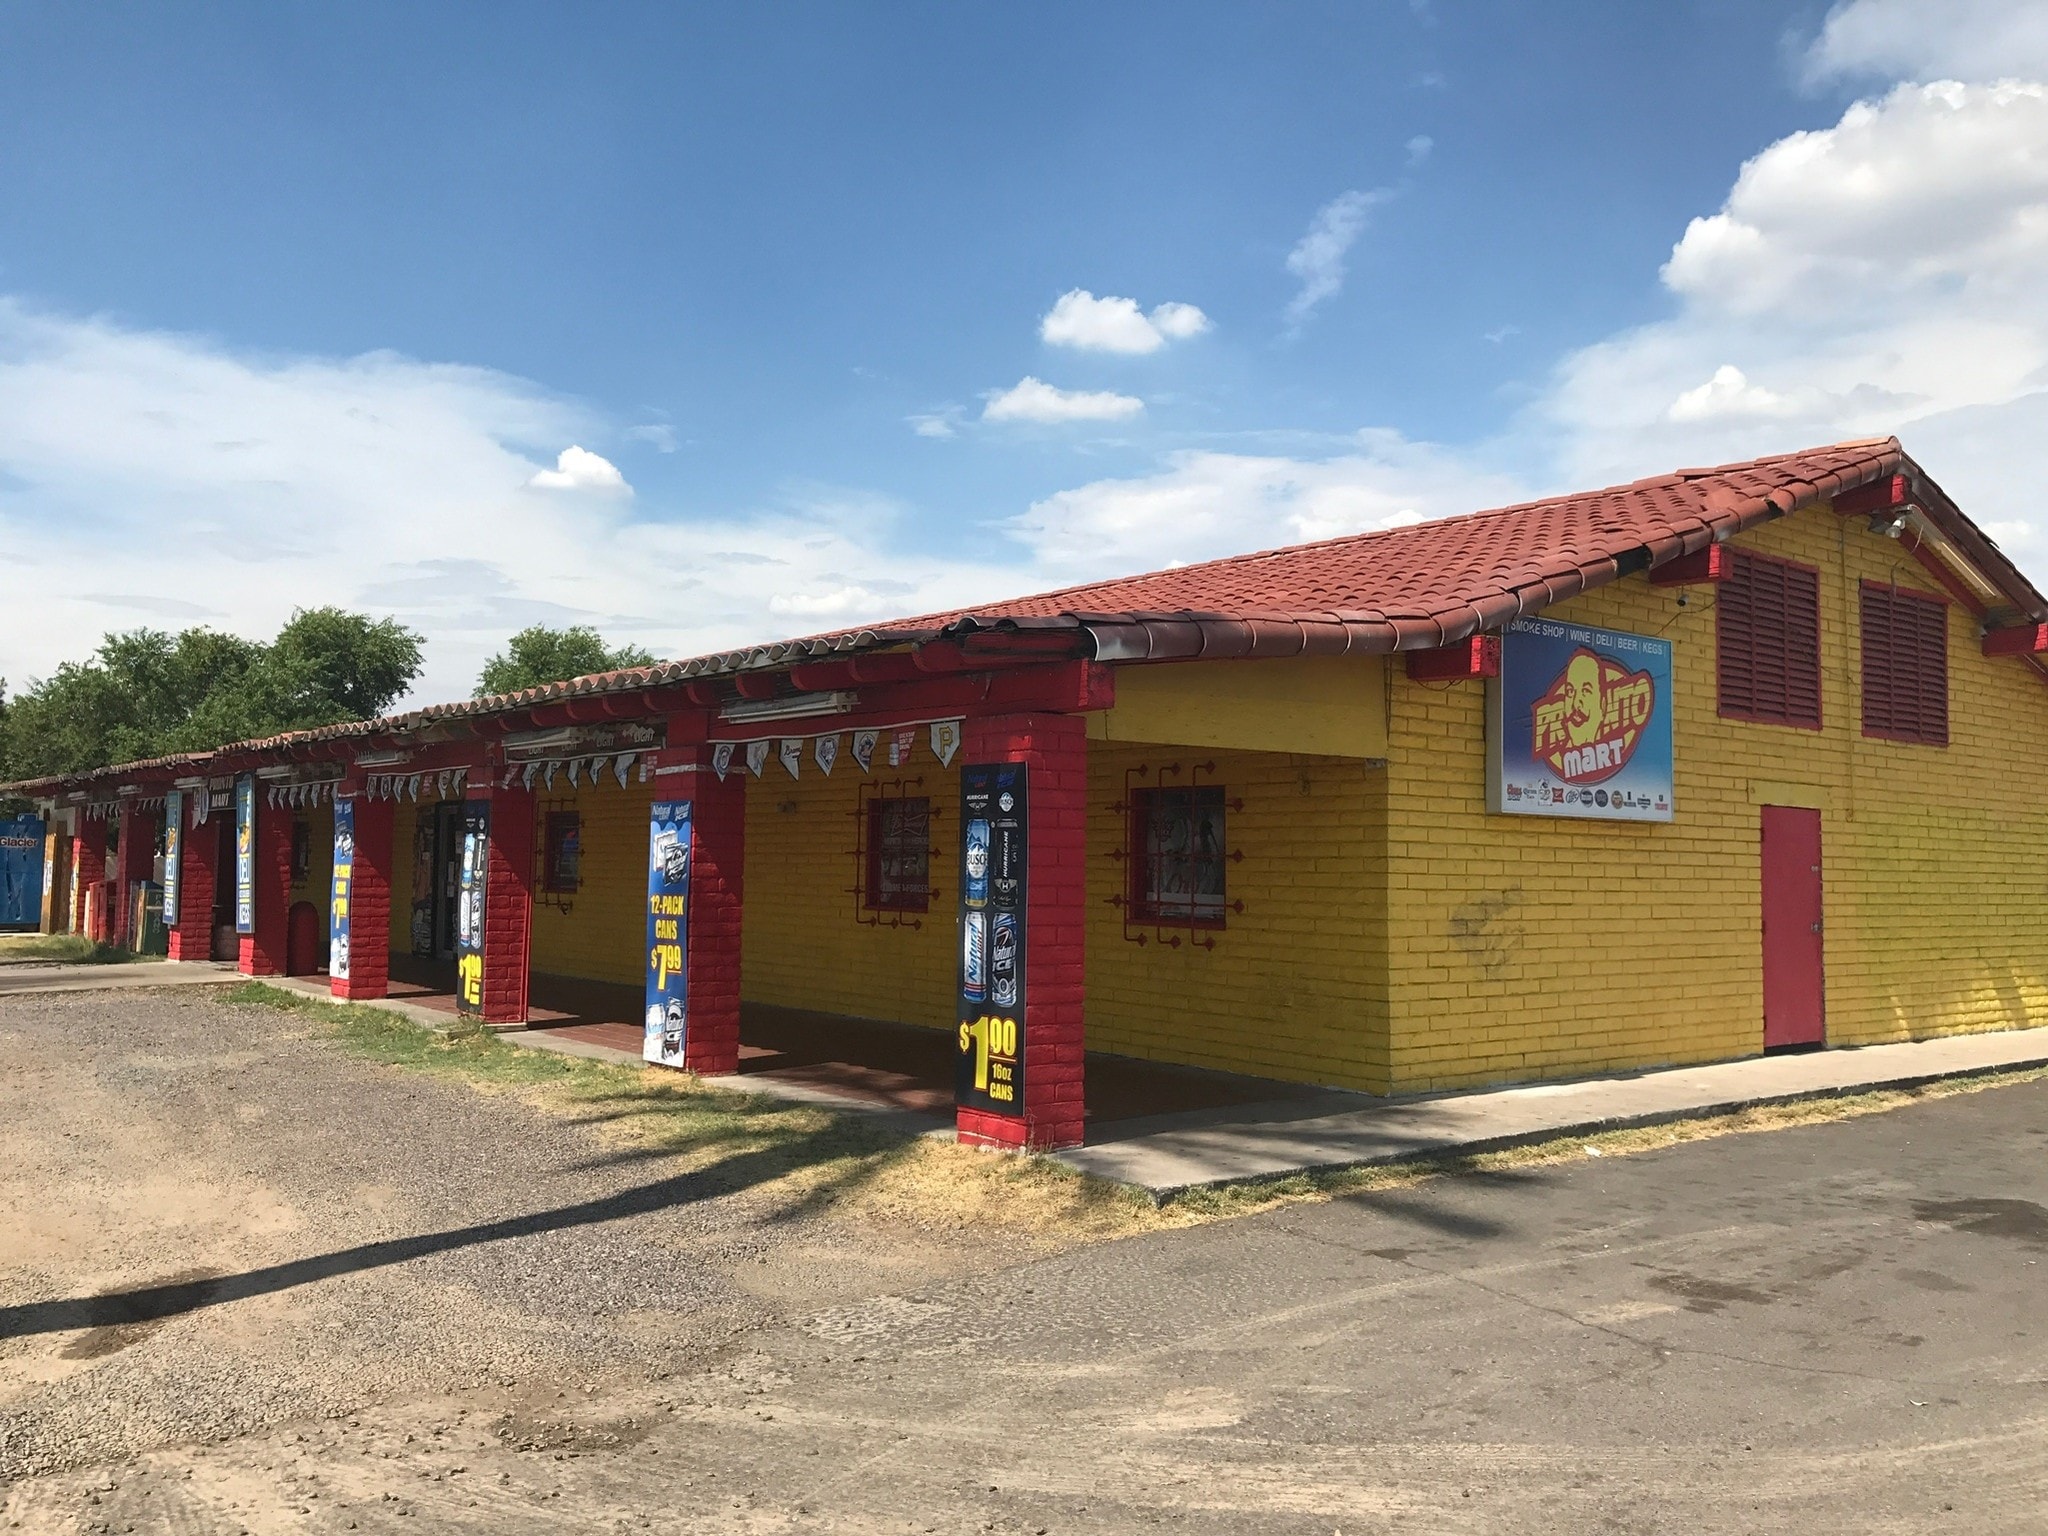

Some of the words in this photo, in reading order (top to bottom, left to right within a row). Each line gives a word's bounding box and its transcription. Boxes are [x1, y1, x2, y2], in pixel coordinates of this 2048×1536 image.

[1511, 621, 1541, 635] SMOKE
[1543, 624, 1564, 638] SHOP
[1570, 630, 1590, 643] WINE
[1596, 633, 1613, 647] DELI
[1618, 637, 1638, 651] BEER
[1643, 643, 1663, 656] KEGS
[1535, 678, 1650, 753] PRNTO
[212, 793, 231, 807] MART
[0, 837, 38, 848] Glacier
[651, 895, 684, 915] 12-PACK
[656, 919, 677, 940] CANS
[990, 1082, 1013, 1102] CANS
